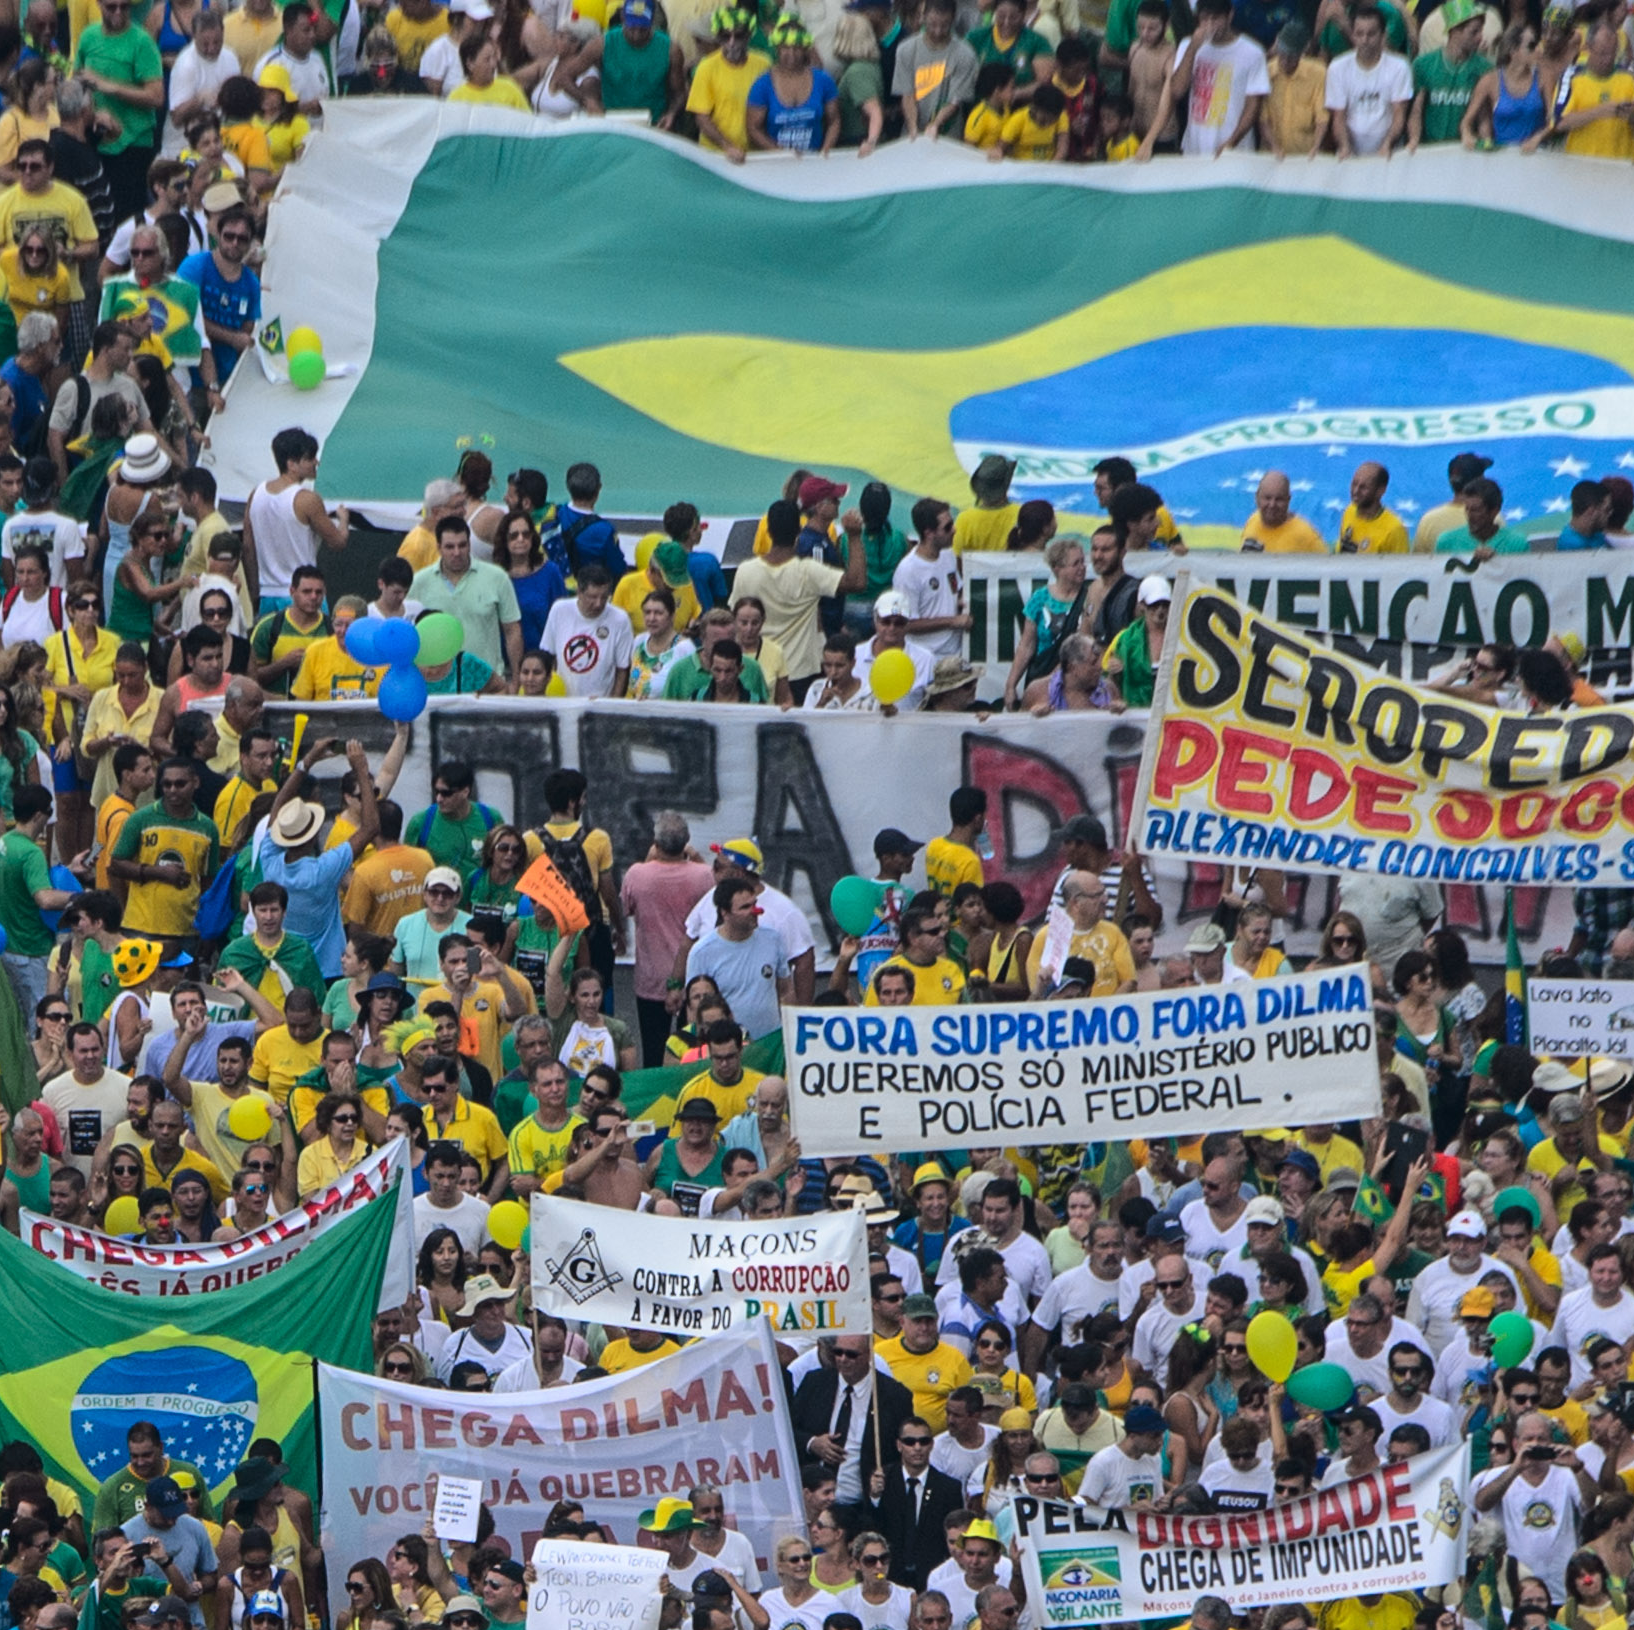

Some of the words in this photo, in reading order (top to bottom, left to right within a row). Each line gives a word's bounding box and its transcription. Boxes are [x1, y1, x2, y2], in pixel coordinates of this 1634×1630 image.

[1199, 401, 1597, 448] PROGRESSO
[974, 558, 1550, 661] INVENÇÃO
[1153, 717, 1418, 836] PEDE
[1145, 809, 1368, 870] ALEXANDRE
[795, 1013, 918, 1056] FORA
[931, 1004, 1141, 1055] SUPREMO,
[1152, 995, 1246, 1041] FORA
[1255, 975, 1369, 1025] DILMA
[1531, 986, 1572, 1004] Lava
[1576, 986, 1613, 1004] Jato
[1533, 1035, 1601, 1054] Planalto
[1569, 1014, 1592, 1029] no
[800, 1058, 1005, 1100] QUEREMOS
[1018, 1048, 1066, 1090] SÓ
[1081, 1036, 1256, 1086] MINISTÉRIO
[1266, 1022, 1372, 1060] PUBLICO
[859, 1105, 883, 1140] E
[919, 1092, 1066, 1138] POLÍCIA
[1087, 1073, 1262, 1124] FEDERAL
[31, 1221, 209, 1266] CHEGA
[224, 1160, 390, 1259] DILMA!
[570, 1257, 597, 1282] G
[687, 1228, 819, 1262] MAÇONS
[632, 1266, 704, 1297] CONTRA
[710, 1269, 724, 1293] A
[731, 1260, 851, 1296] CORRUPÇÃO
[650, 1300, 703, 1331] FAVOR
[710, 1304, 732, 1331] DO
[81, 1396, 136, 1408] ORDEM
[146, 1396, 156, 1407] E
[161, 1396, 251, 1416] PROGRESSO
[340, 1400, 547, 1452] CHEGA
[560, 1361, 778, 1446] DILMA!
[540, 1449, 781, 1501] QUEBRARAM
[1014, 1495, 1129, 1537] PELA
[1136, 1463, 1416, 1550] DIGNIDADE
[1139, 1549, 1225, 1595] CHEGA
[1231, 1546, 1265, 1583] DE
[1271, 1520, 1424, 1582] IMPUNIDADE
[557, 1597, 600, 1618] POVO
[1143, 1598, 1192, 1613] Maçons
[1237, 1592, 1254, 1604] de
[1257, 1587, 1305, 1603] Janeiro
[1308, 1583, 1348, 1597] contra
[1351, 1581, 1360, 1591] a
[1362, 1571, 1428, 1593] corrupção
